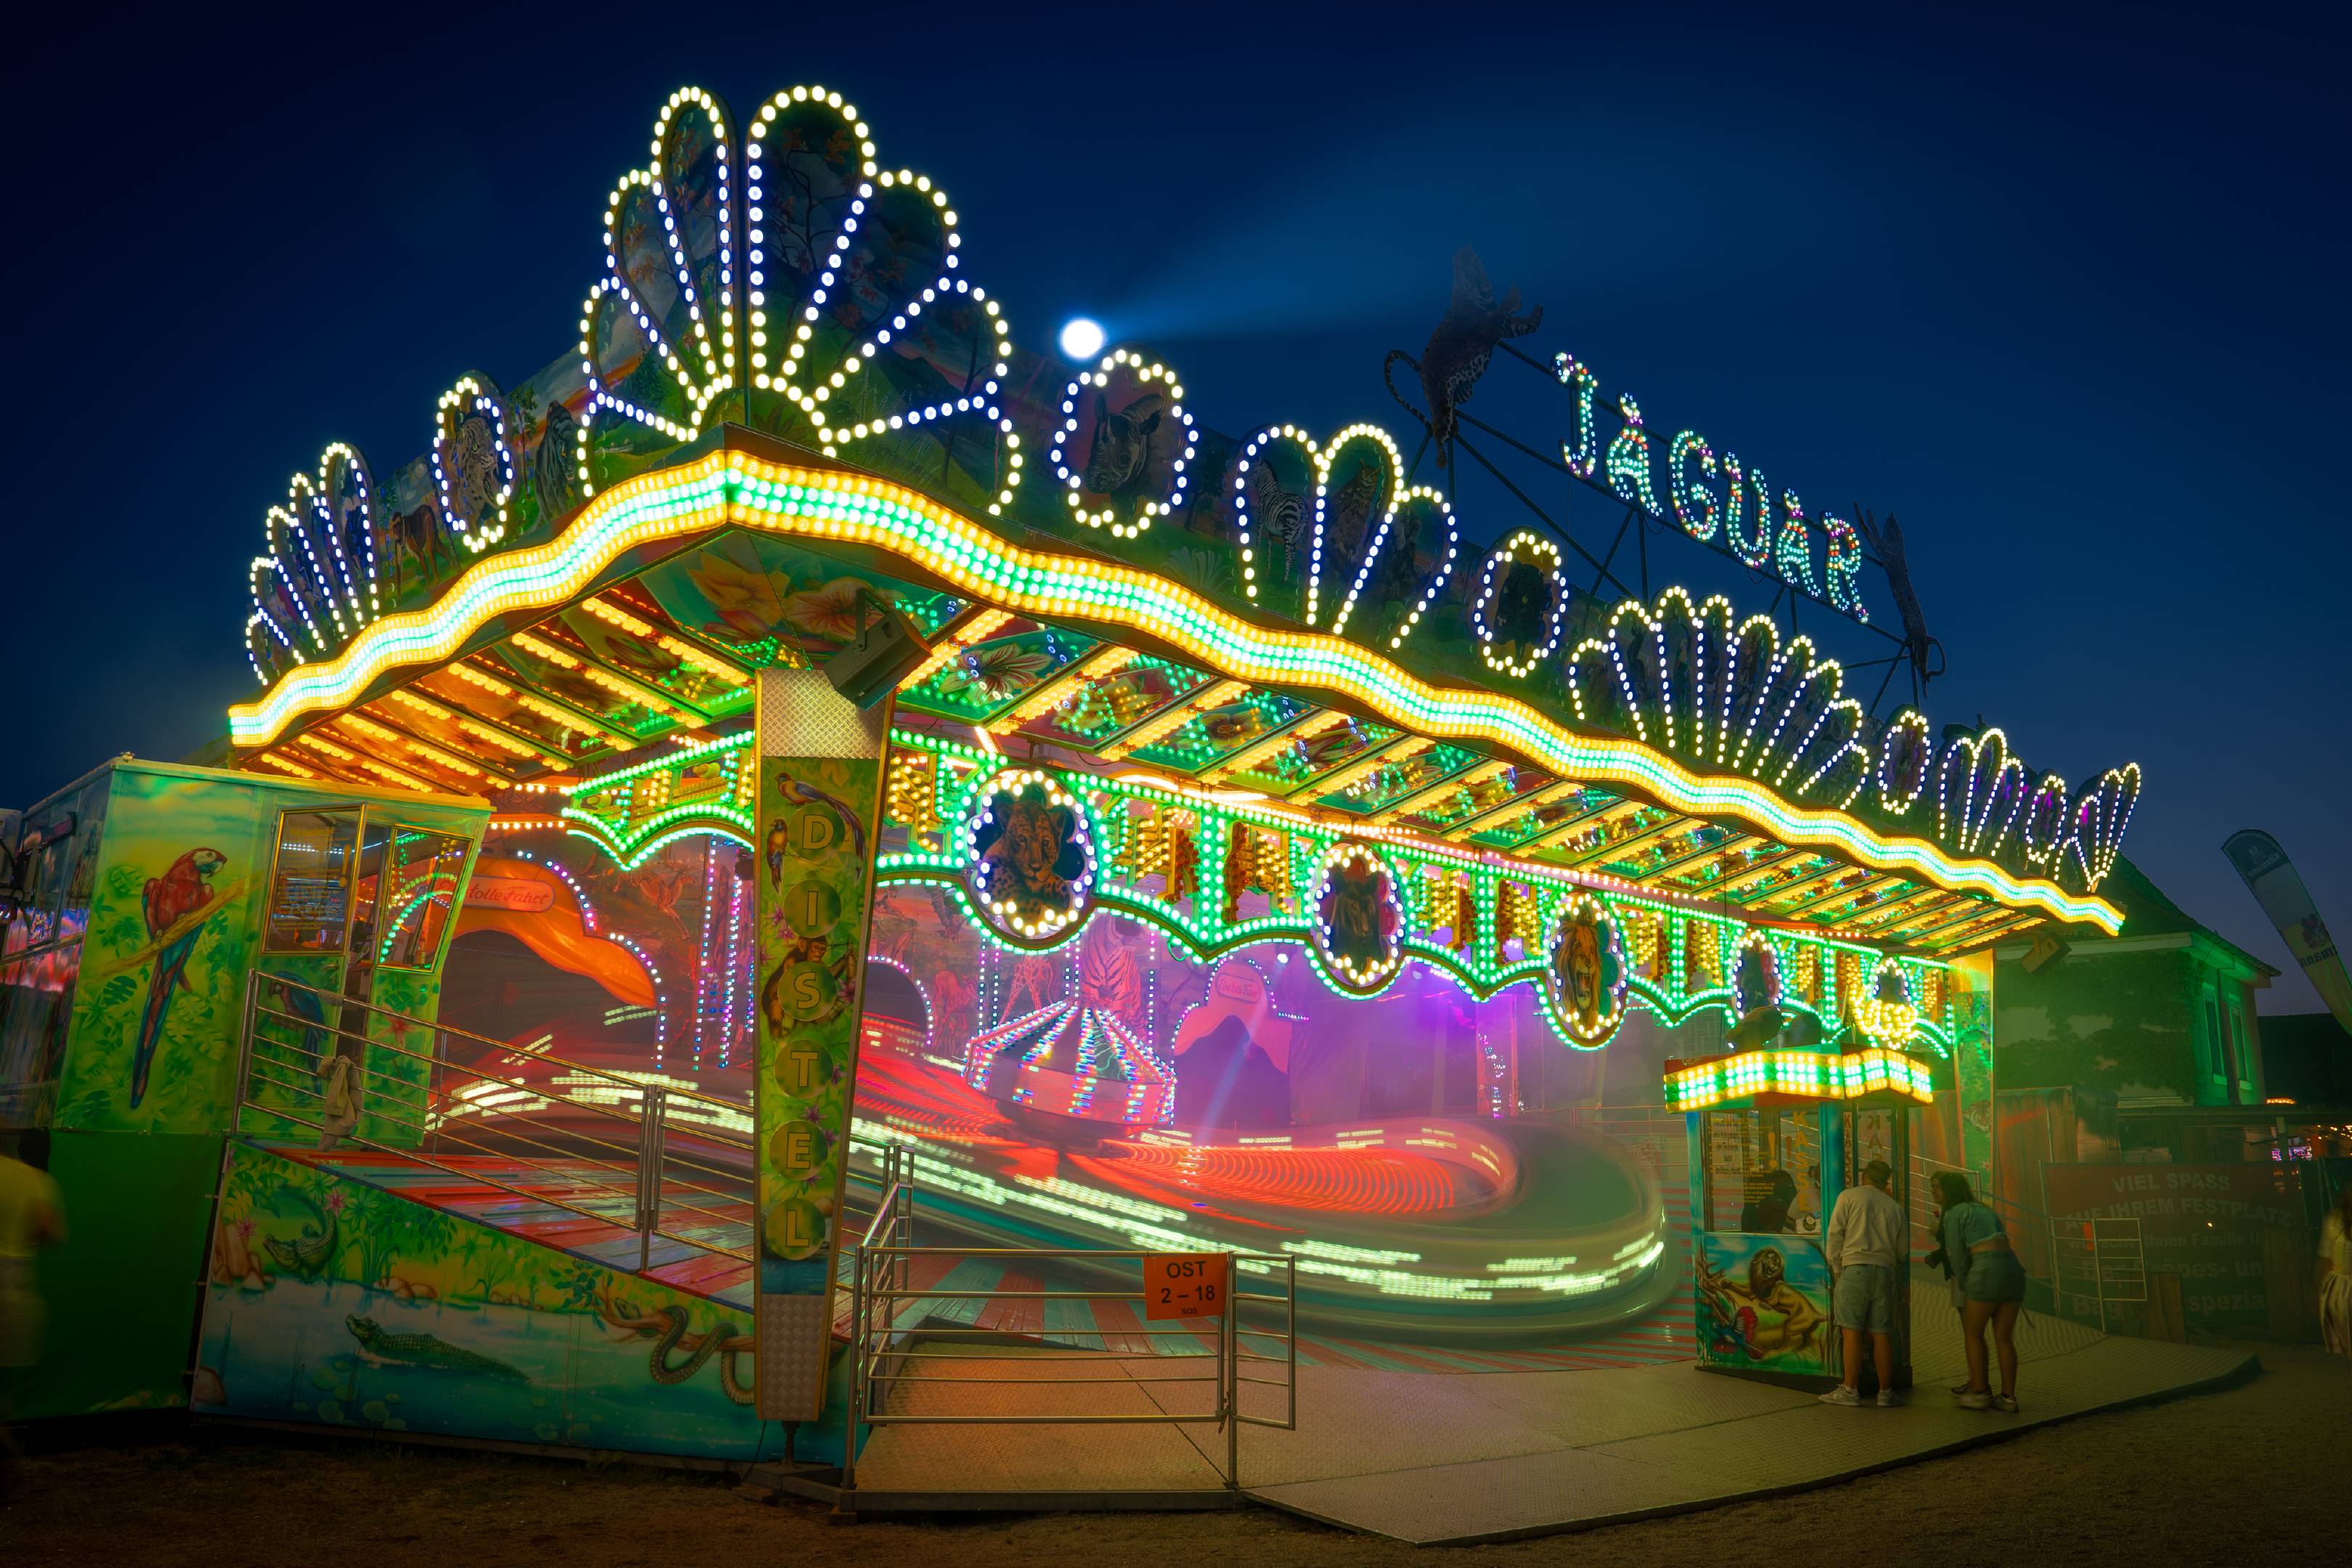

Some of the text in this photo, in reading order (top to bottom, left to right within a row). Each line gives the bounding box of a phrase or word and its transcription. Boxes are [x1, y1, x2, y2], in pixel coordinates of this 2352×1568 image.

[1551, 351, 1869, 624] JAGUAR
[470, 883, 550, 905] tolle Fahrt
[785, 814, 836, 1248] DISTEL
[1792, 1111, 1813, 1211] KASSE
[2112, 1172, 2230, 1193] VIEL SPASS
[2108, 1198, 2175, 1218] IHREM
[2181, 1196, 2292, 1226] FESTPLATZ
[1167, 1261, 1206, 1278] OST
[1161, 1288, 1172, 1304] 2
[1195, 1285, 1215, 1302] 18
